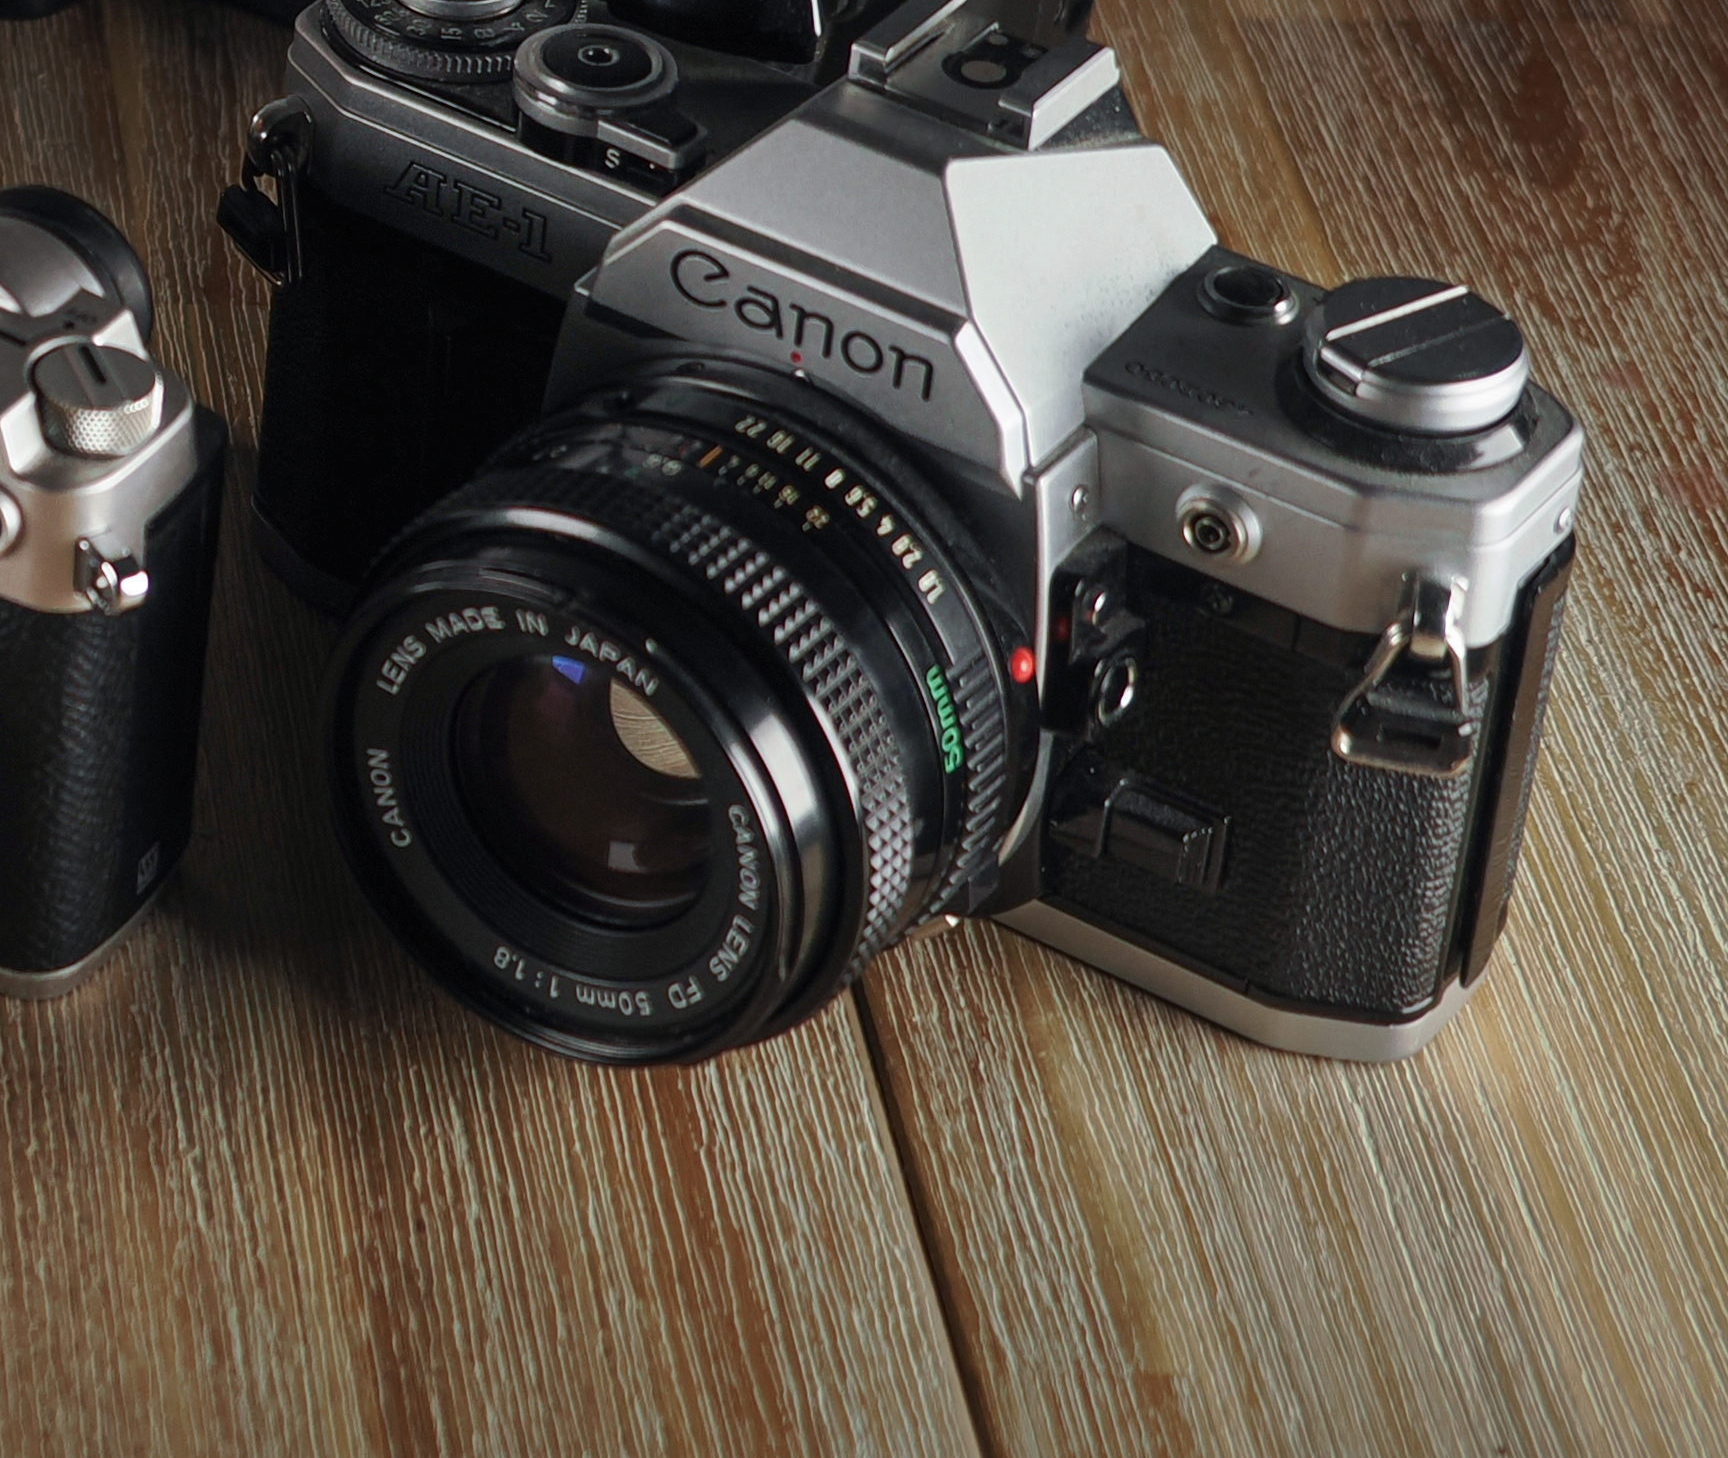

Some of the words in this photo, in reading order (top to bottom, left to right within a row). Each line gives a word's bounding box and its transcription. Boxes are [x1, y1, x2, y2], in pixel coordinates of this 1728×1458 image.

[605, 148, 619, 167] S
[384, 160, 552, 264] AE-1
[670, 249, 934, 403] Canon
[376, 635, 426, 695] LENS
[425, 606, 506, 643] MADE
[516, 609, 549, 636] IN
[565, 626, 659, 696] JAPAN
[926, 663, 964, 774] 50mm
[366, 748, 413, 848] CANON
[728, 804, 760, 911] CANON
[668, 976, 705, 1010] FD
[709, 914, 755, 982] LENS
[575, 984, 653, 1016] 50mm
